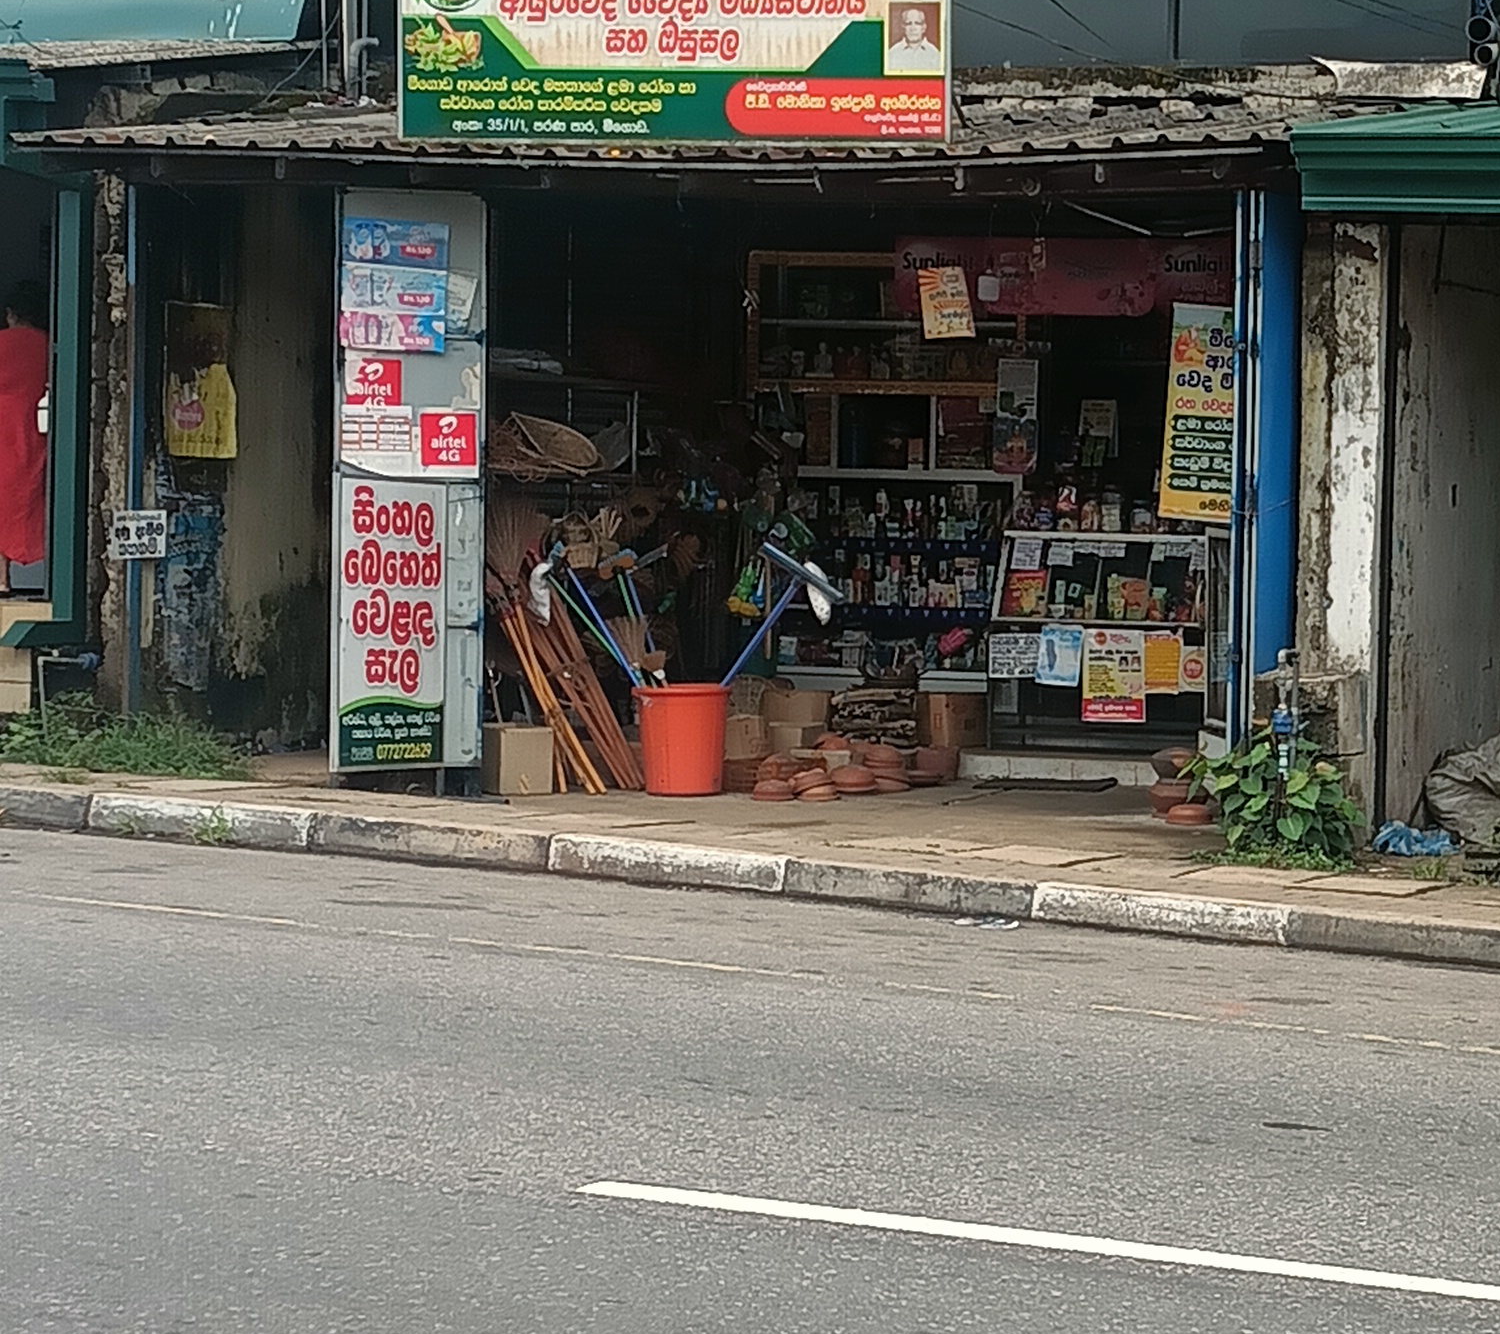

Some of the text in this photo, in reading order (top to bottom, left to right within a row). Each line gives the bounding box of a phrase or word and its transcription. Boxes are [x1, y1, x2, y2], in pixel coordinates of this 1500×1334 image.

[605, 27, 648, 54] සහ
[429, 434, 467, 450] airtel
[437, 450, 461, 462] 4G
[352, 485, 435, 547] සිංහල
[345, 538, 442, 587] බෙහෙත්
[364, 648, 420, 694] සැල
